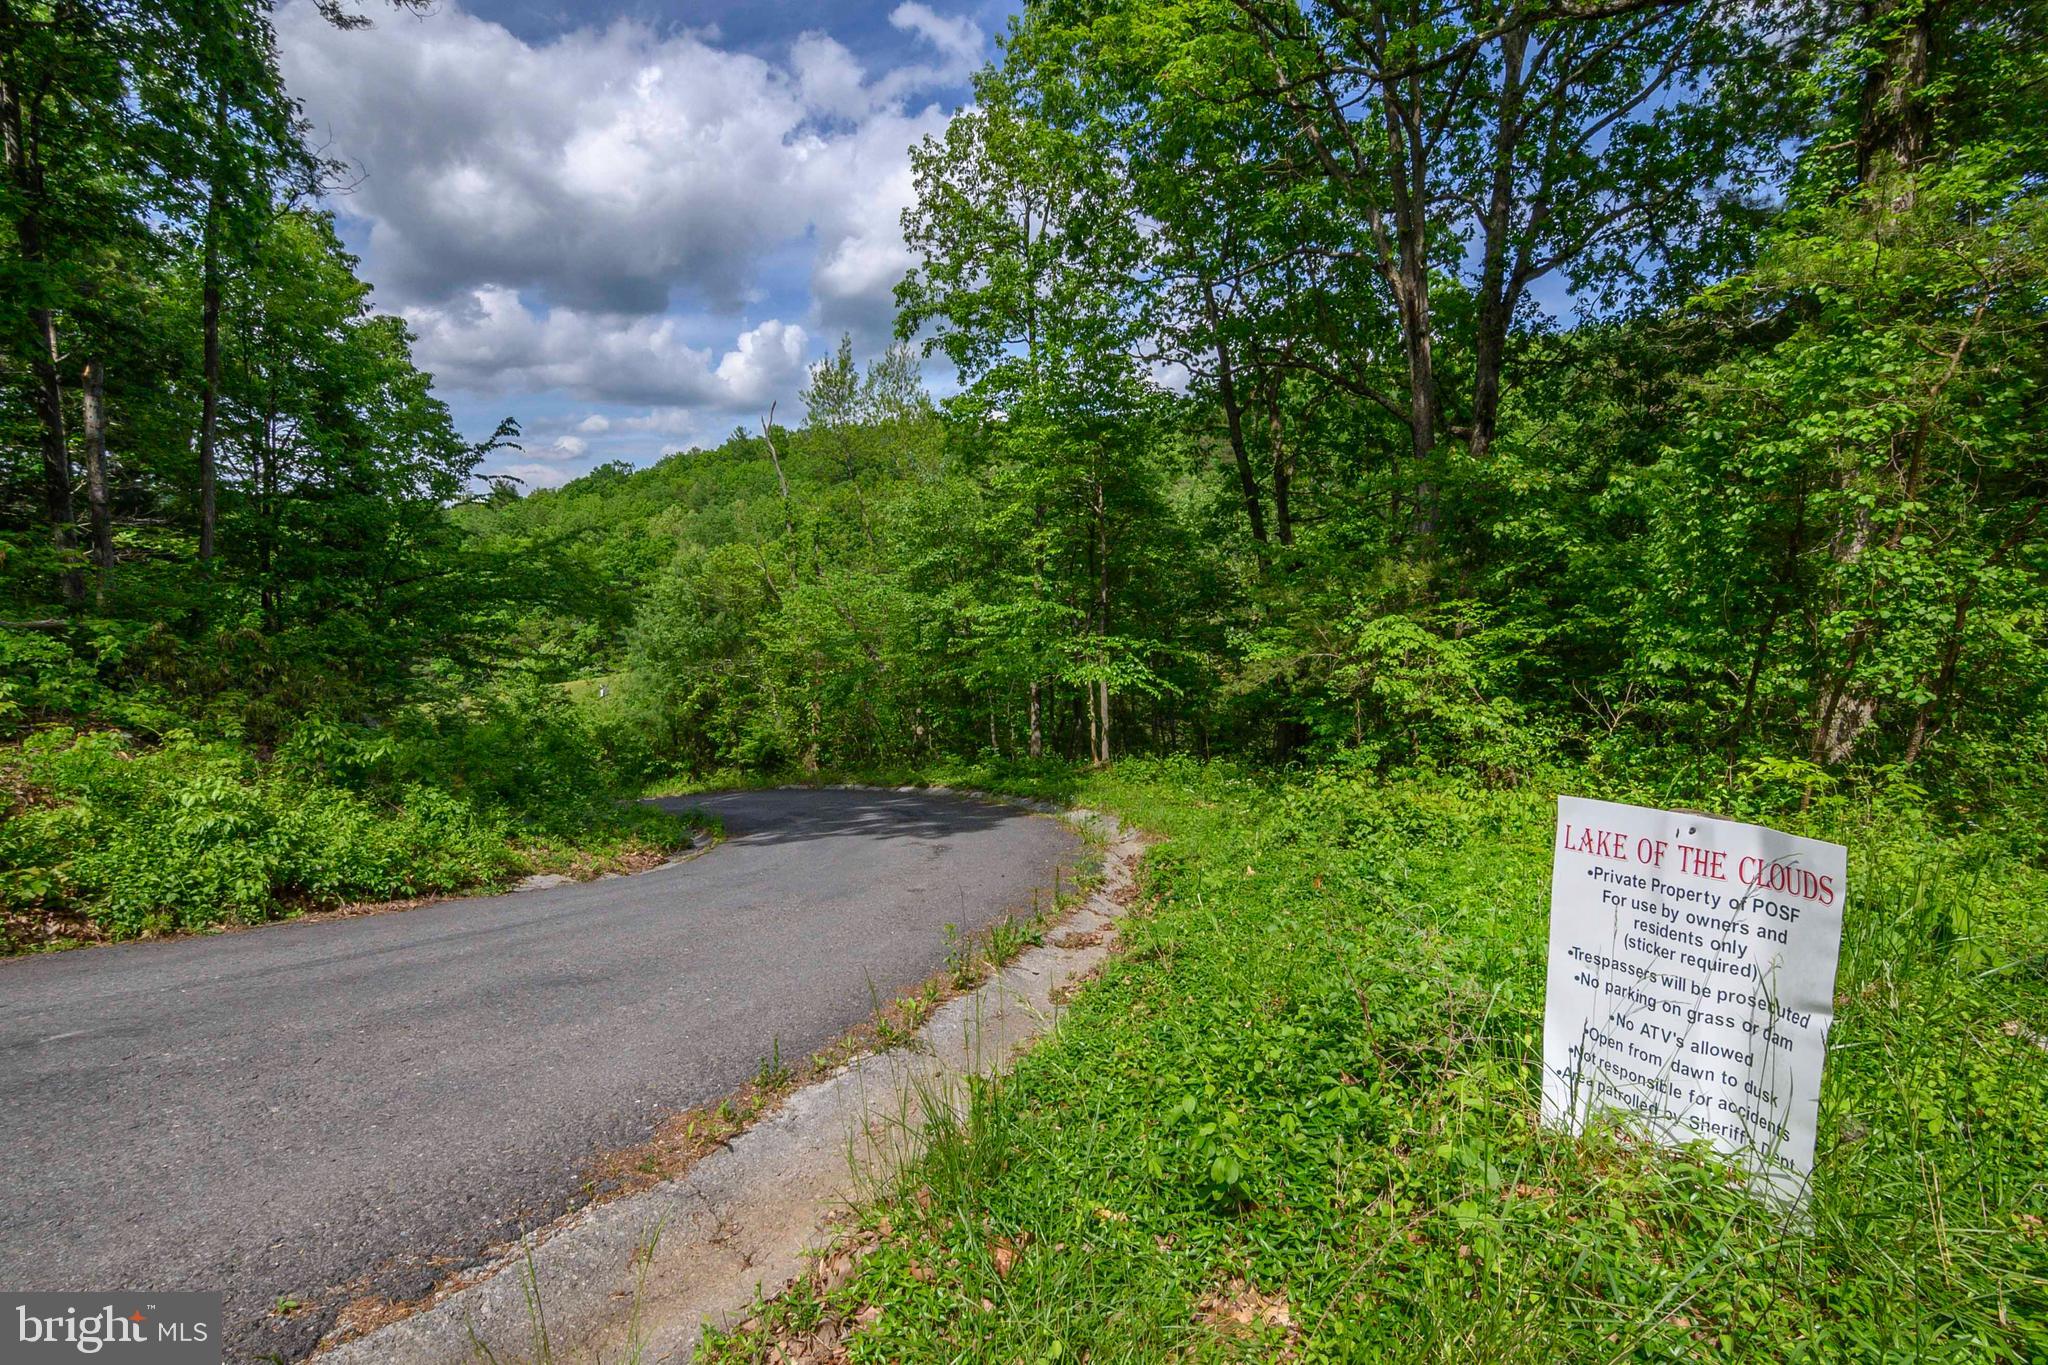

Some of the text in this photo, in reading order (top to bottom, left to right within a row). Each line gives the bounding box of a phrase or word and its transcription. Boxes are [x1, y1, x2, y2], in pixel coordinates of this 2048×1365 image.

[1564, 824, 1835, 905] LAKE OF THE CLOUDS
[1603, 890, 1788, 944] For use by owners and
[1651, 878, 1721, 910] Property
[1729, 897, 1747, 911] of
[1753, 898, 1801, 923] POSF
[1624, 933, 1757, 982] (sticker required)
[1634, 919, 1748, 959] residents only
[1661, 975, 1686, 992] will
[1691, 981, 1711, 998] be
[1605, 982, 1656, 1011] parking
[1662, 1001, 1681, 1016] on
[1687, 1008, 1735, 1028] grass
[1742, 1020, 1759, 1035] or
[1763, 1027, 1793, 1052] dam
[1640, 1023, 1684, 1048] ATV's
[1690, 1041, 1754, 1067] allowed
[1598, 1082, 1658, 1115] patrolled
[1599, 1058, 1682, 1098] responsible
[1689, 1090, 1713, 1107] for
[1718, 1099, 1790, 1142] accidents
[1629, 1043, 1662, 1067] from
[1671, 1060, 1714, 1081] dawn
[1722, 1071, 1738, 1087] to
[1744, 1081, 1779, 1108] dusk
